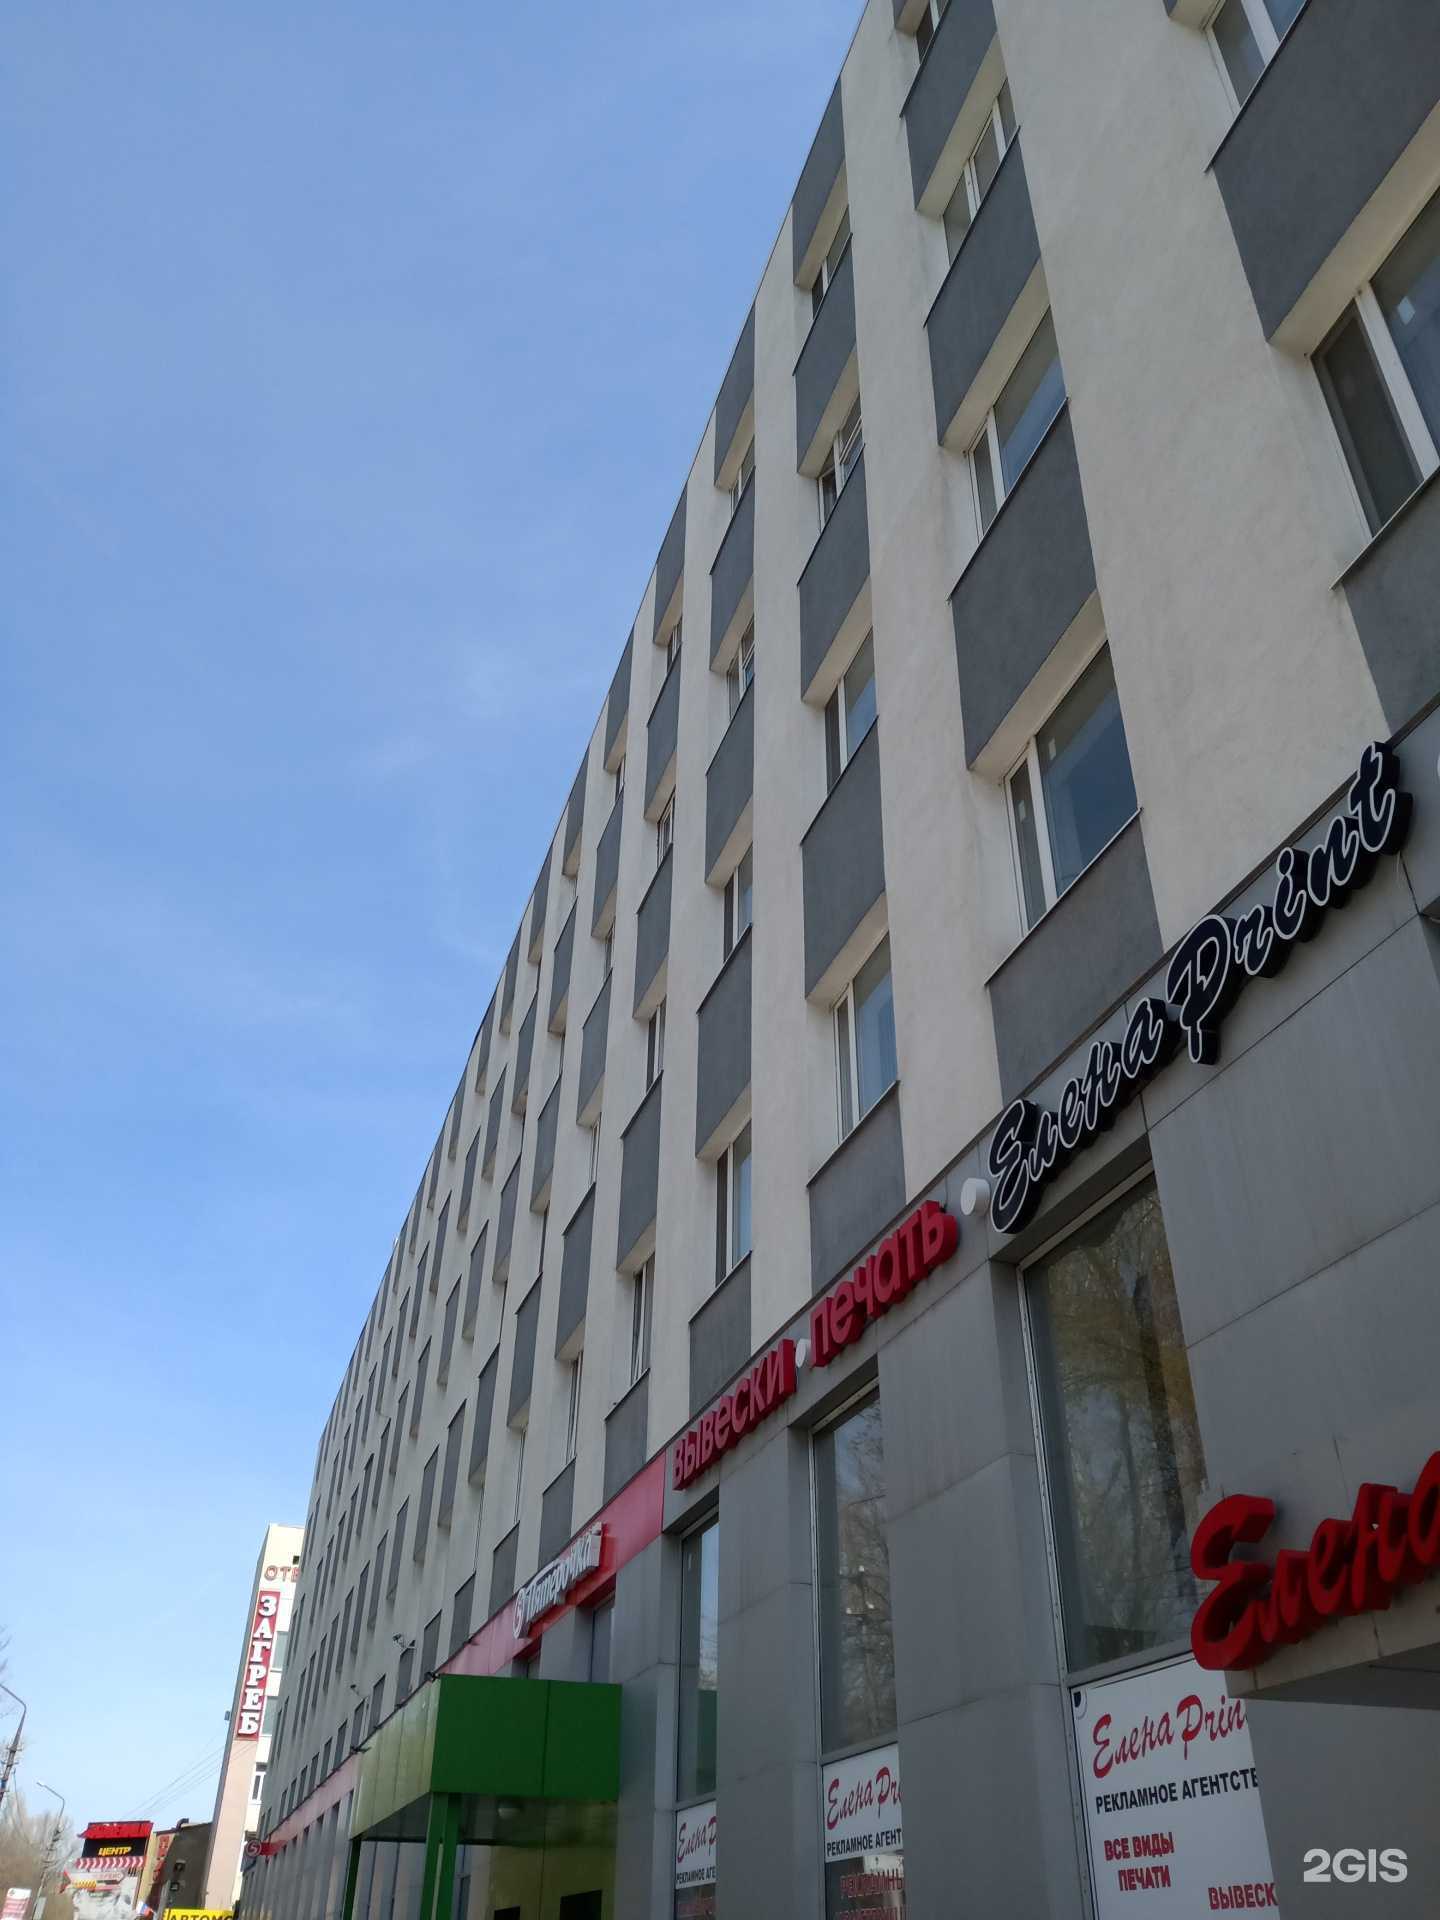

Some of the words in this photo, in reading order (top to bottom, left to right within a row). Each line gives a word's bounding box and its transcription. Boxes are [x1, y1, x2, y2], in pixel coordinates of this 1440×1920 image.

[989, 998, 1180, 1233] Елена
[1166, 741, 1413, 1065] Print
[237, 1594, 278, 1736] ЗАГРЕБ
[1092, 1713, 1175, 1779] Елена
[1177, 1694, 1248, 1760] Prin
[826, 1778, 875, 1831] Елена
[1095, 1782, 1178, 1815] РЕКЛАМНОЕ
[98, 1846, 132, 1857] ЦЕНТР
[826, 1834, 873, 1857] РЕКЛАМНОЕ
[875, 1828, 902, 1848] АГЕНТ
[1104, 1837, 1130, 1861] ВСЕ
[1132, 1831, 1175, 1858] ВИДЫ
[1118, 1865, 1172, 1892] ПЕЧАТИ
[1208, 1882, 1279, 1910] ВЫВЕСК
